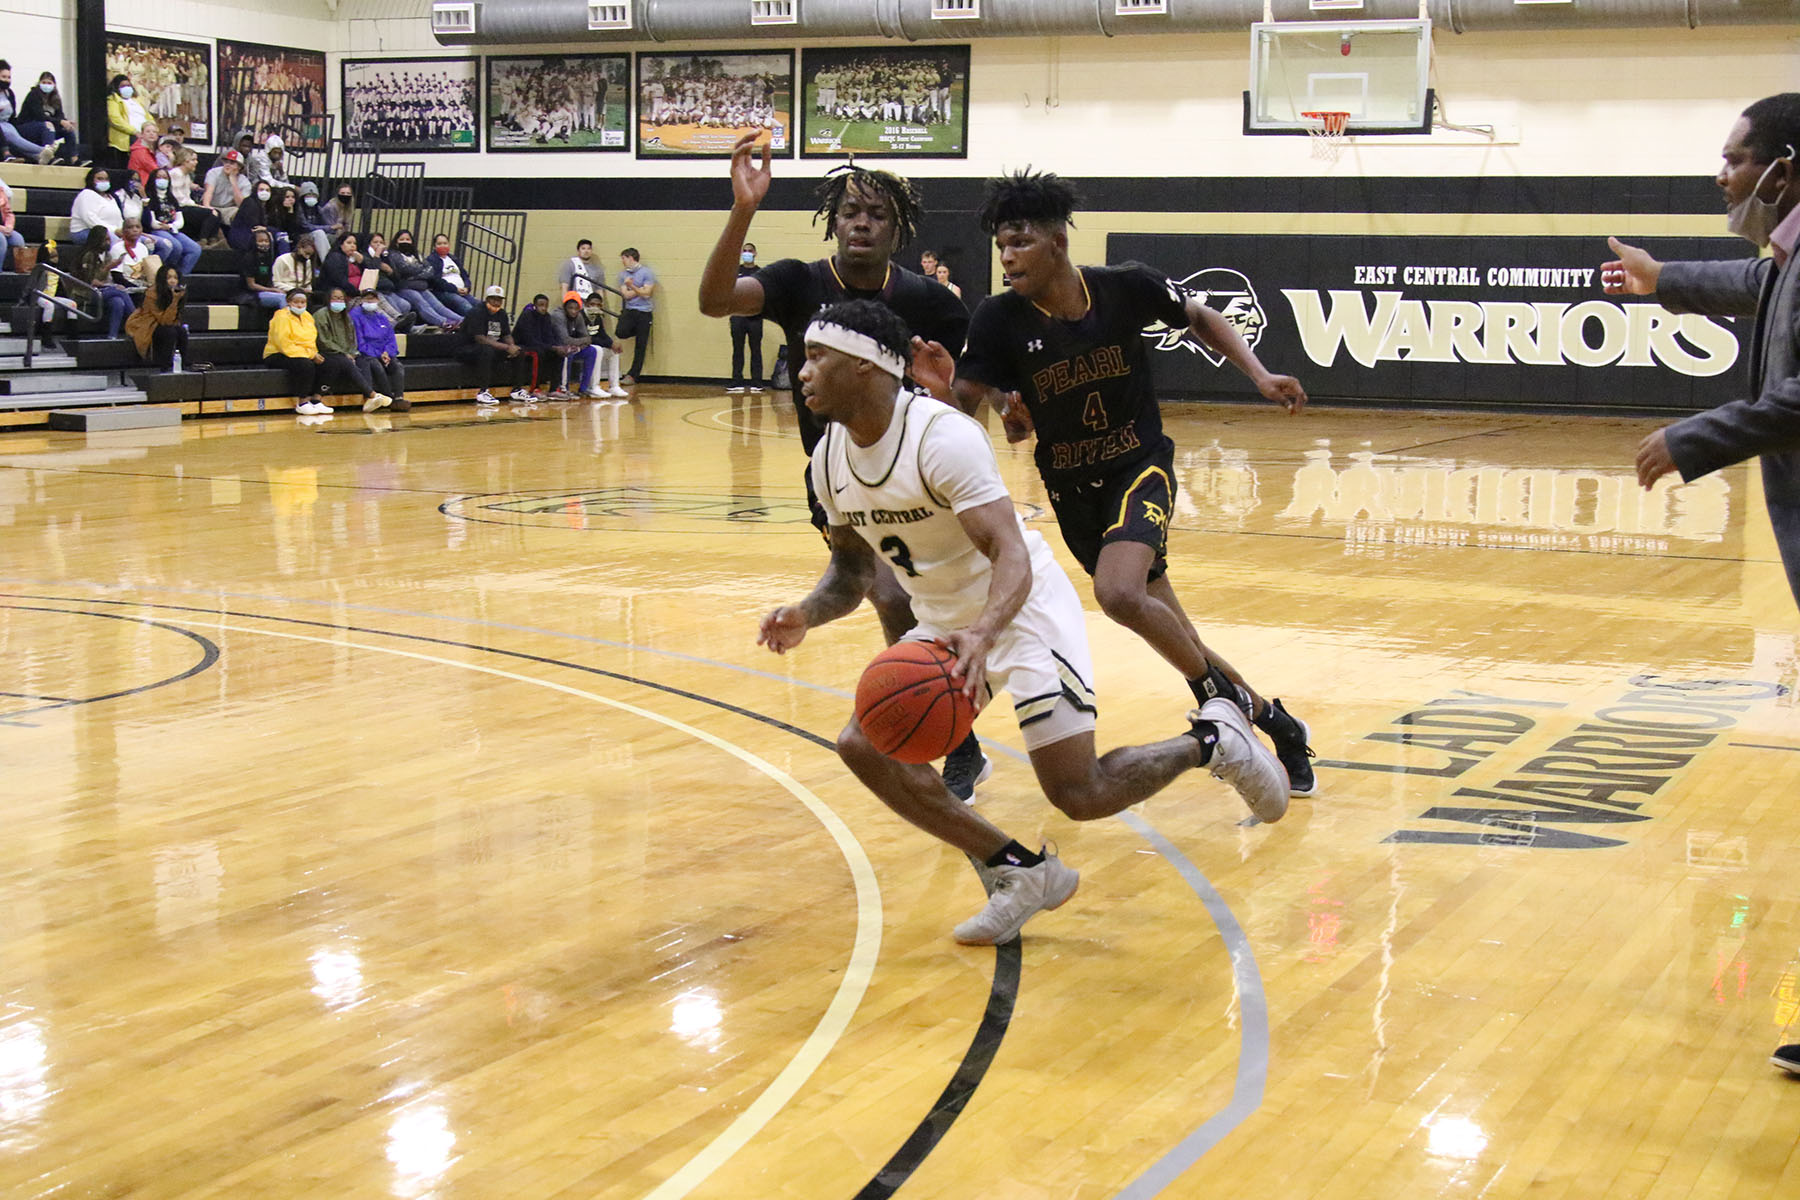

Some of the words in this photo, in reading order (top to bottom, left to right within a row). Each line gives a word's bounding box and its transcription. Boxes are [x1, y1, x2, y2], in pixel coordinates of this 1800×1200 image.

[884, 126, 900, 134] 2016
[1354, 266, 1397, 284] EAST
[1403, 267, 1480, 286] CENTRAL
[1487, 267, 1595, 288] COMMUNITY
[1280, 289, 1740, 377] WARRIORS
[1032, 345, 1131, 403] PEARL
[1082, 391, 1108, 431] 4
[1051, 419, 1140, 469] RIVER
[871, 507, 934, 525] CENTRAL
[1311, 689, 1569, 778] LADY
[1380, 675, 1790, 849] WARRIORS
